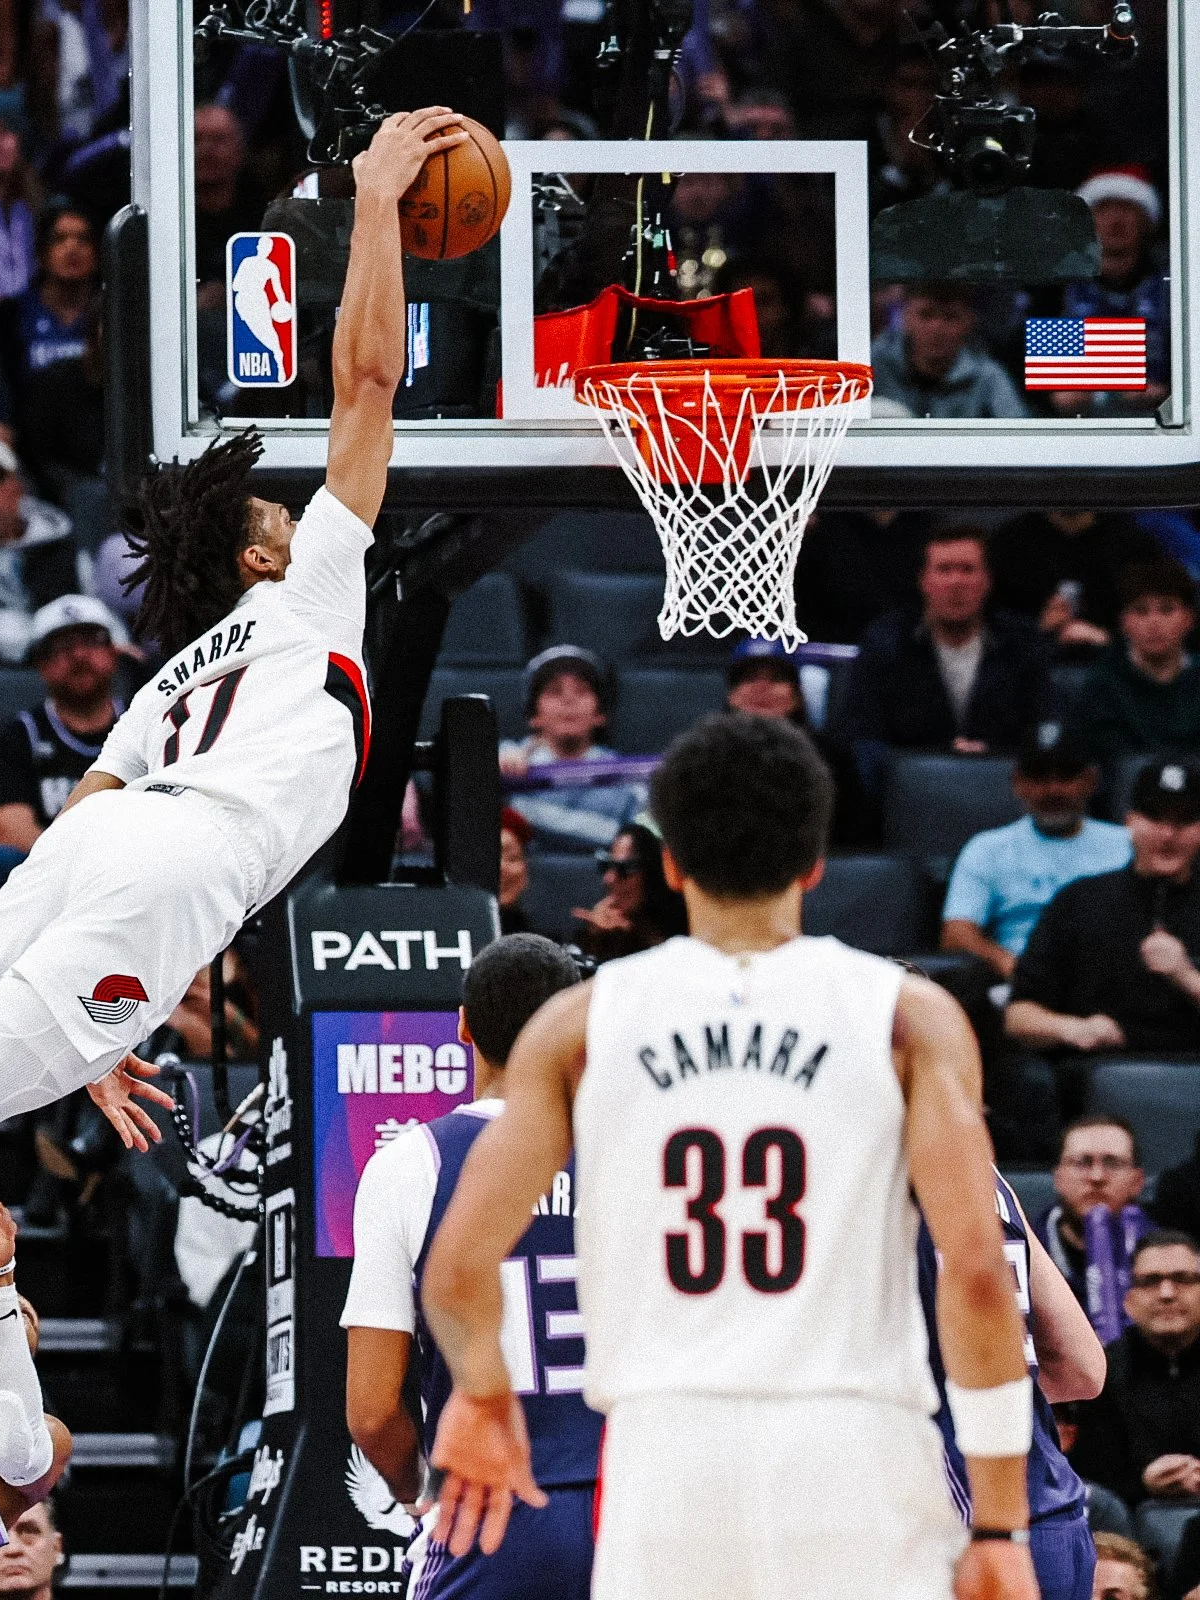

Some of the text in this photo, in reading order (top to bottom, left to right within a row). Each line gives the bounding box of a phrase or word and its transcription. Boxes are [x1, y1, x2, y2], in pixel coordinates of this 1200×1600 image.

[239, 352, 271, 377] NBA
[157, 620, 257, 697] SHARPE
[311, 930, 473, 971] PATH
[337, 1043, 468, 1095] MEBO
[638, 1022, 829, 1091] CAMARA
[662, 1125, 807, 1295] 33
[325, 1580, 403, 1594] RESORT
